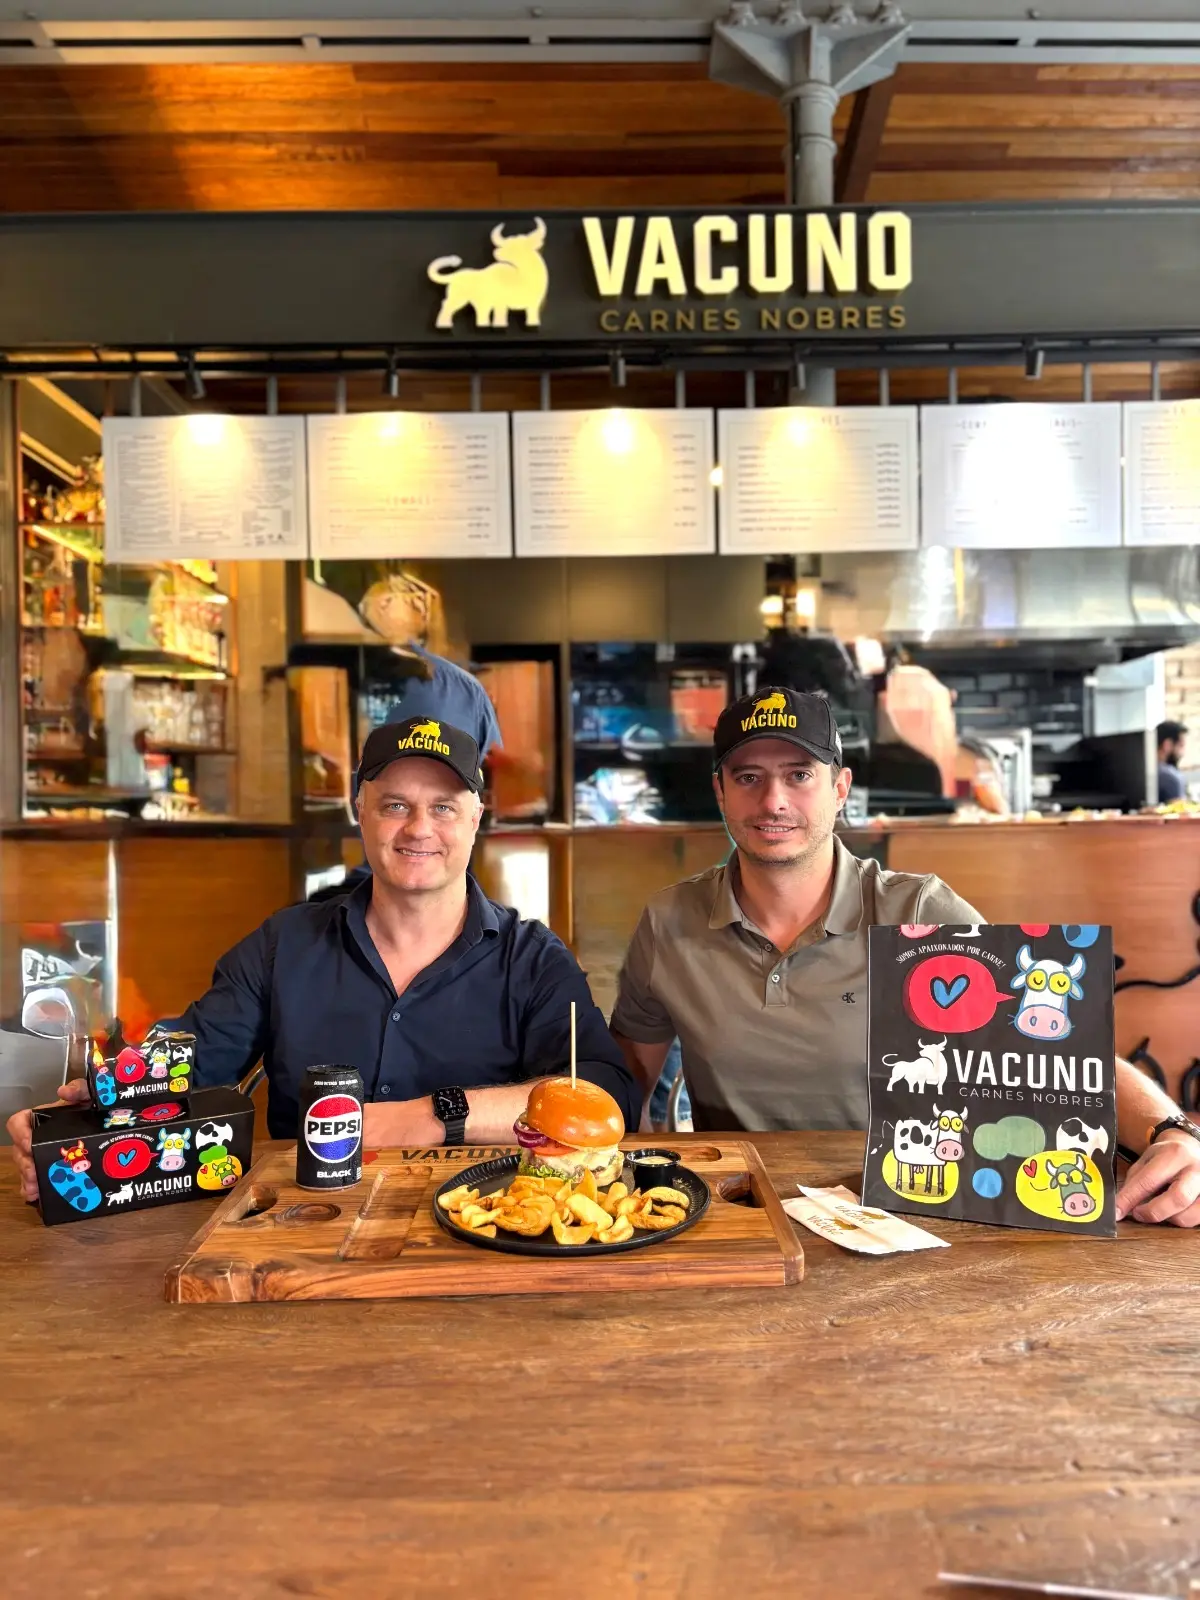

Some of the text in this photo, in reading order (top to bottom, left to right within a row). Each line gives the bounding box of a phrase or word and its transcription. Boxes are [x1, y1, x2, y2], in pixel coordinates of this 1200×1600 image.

[582, 211, 912, 296] VACUNO
[600, 306, 907, 332] CARNES NOBRES
[741, 713, 797, 732] VACUNO
[398, 738, 450, 756] VACUNO
[896, 944, 1007, 970] SOMOS APAIXONADOS POR CARNE!
[952, 1048, 1104, 1094] VACUNO
[135, 1081, 168, 1094] VACUNO
[959, 1087, 1105, 1109] CARNES NOBRES
[307, 1118, 361, 1136] PEPSI
[316, 1169, 352, 1178] BLACK
[134, 1175, 192, 1196] VACUNO
